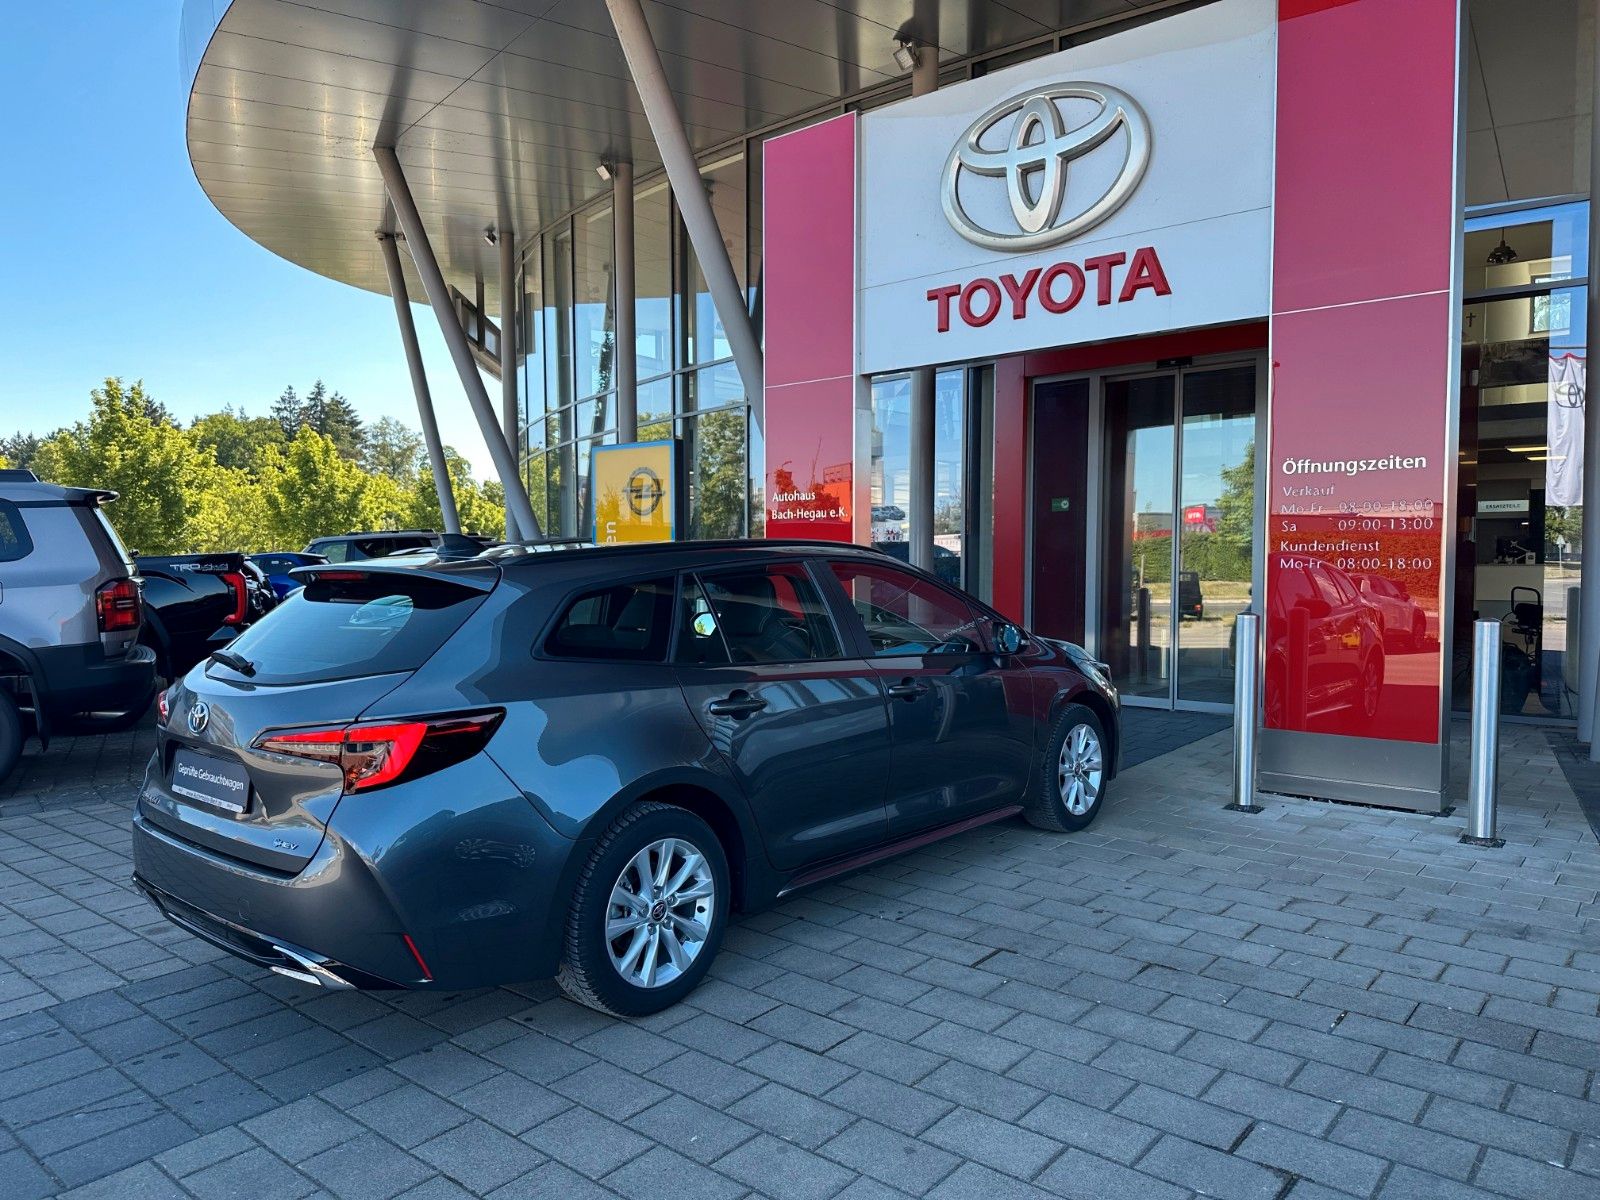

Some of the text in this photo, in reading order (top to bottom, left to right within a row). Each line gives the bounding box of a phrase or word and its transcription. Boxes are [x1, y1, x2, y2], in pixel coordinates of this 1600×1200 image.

[926, 246, 1172, 333] TOYOTA
[1282, 454, 1427, 476] Öffnungszeiten
[772, 490, 816, 502] Autohaus
[1282, 484, 1335, 497] Verkauf
[771, 507, 849, 522] Bach-Hegau e.K.
[1281, 517, 1434, 532] Sa 09:00-13:00
[1280, 540, 1380, 552] Kundendienst
[1280, 557, 1432, 570] Mo-Fr 08:00-18:00
[177, 762, 244, 791] Geprüfte Gebrauchtwagen
